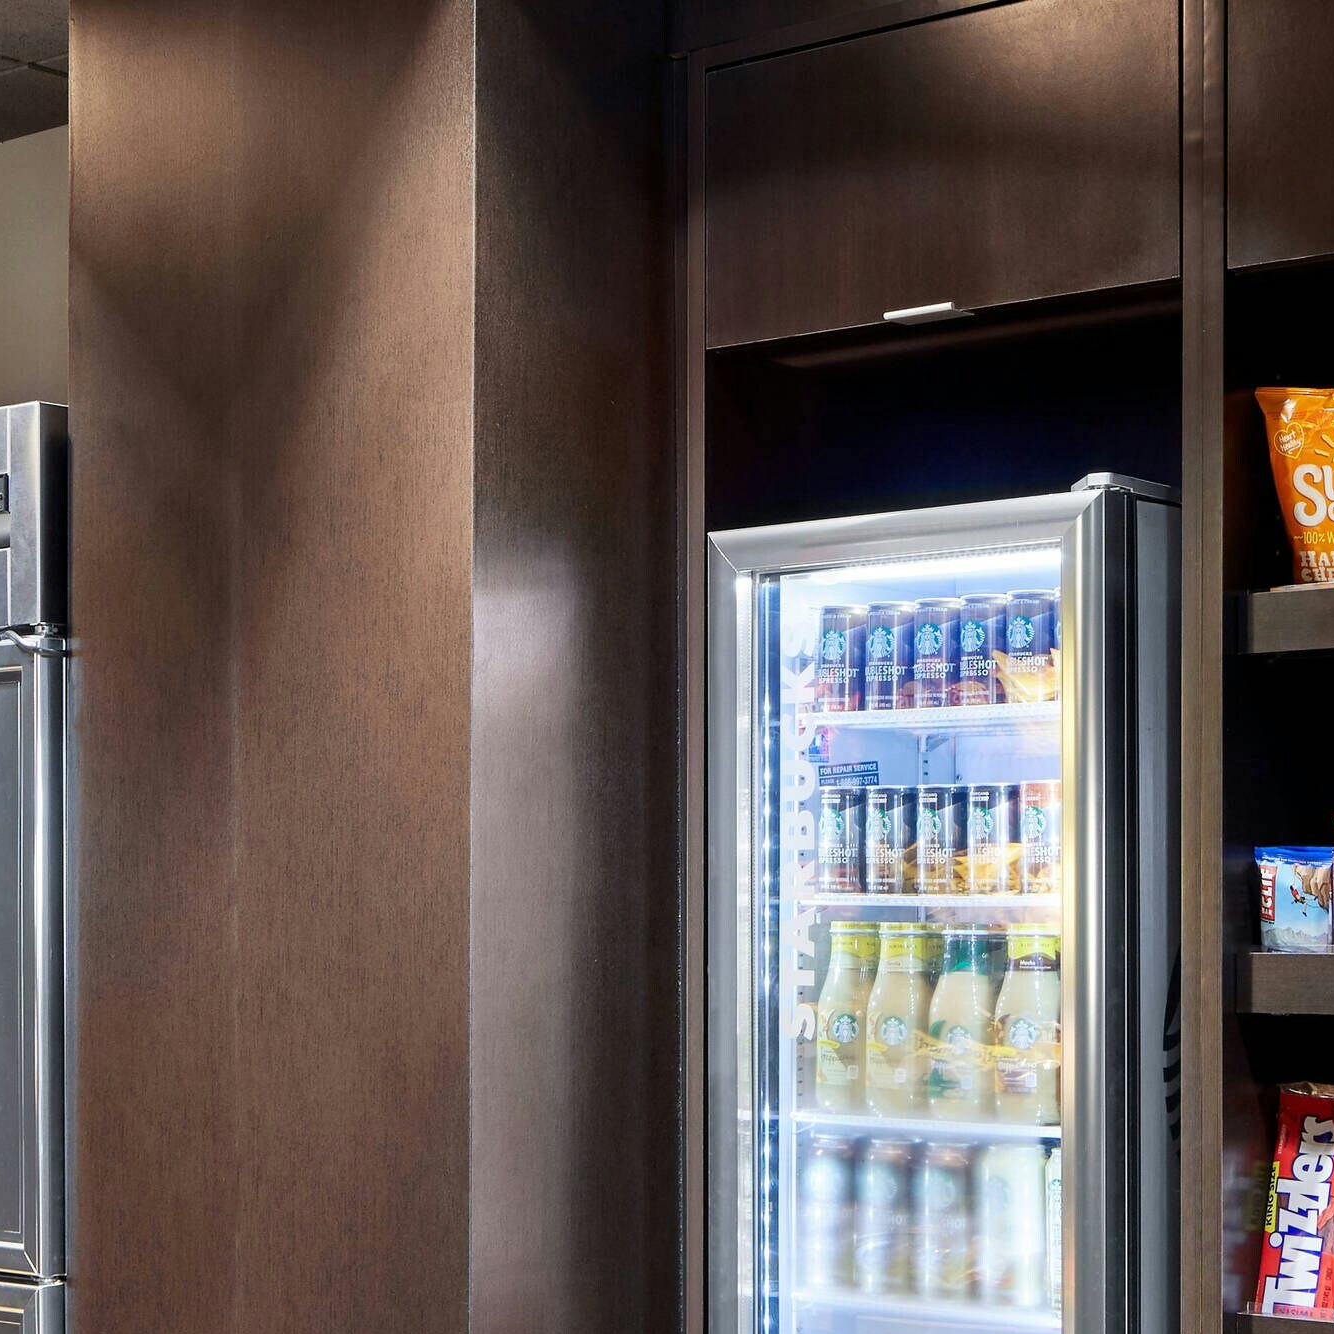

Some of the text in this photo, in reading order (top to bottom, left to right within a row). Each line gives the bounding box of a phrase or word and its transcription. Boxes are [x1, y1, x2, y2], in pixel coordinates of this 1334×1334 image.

[820, 763, 877, 775] FOR REPAIR SERVICE
